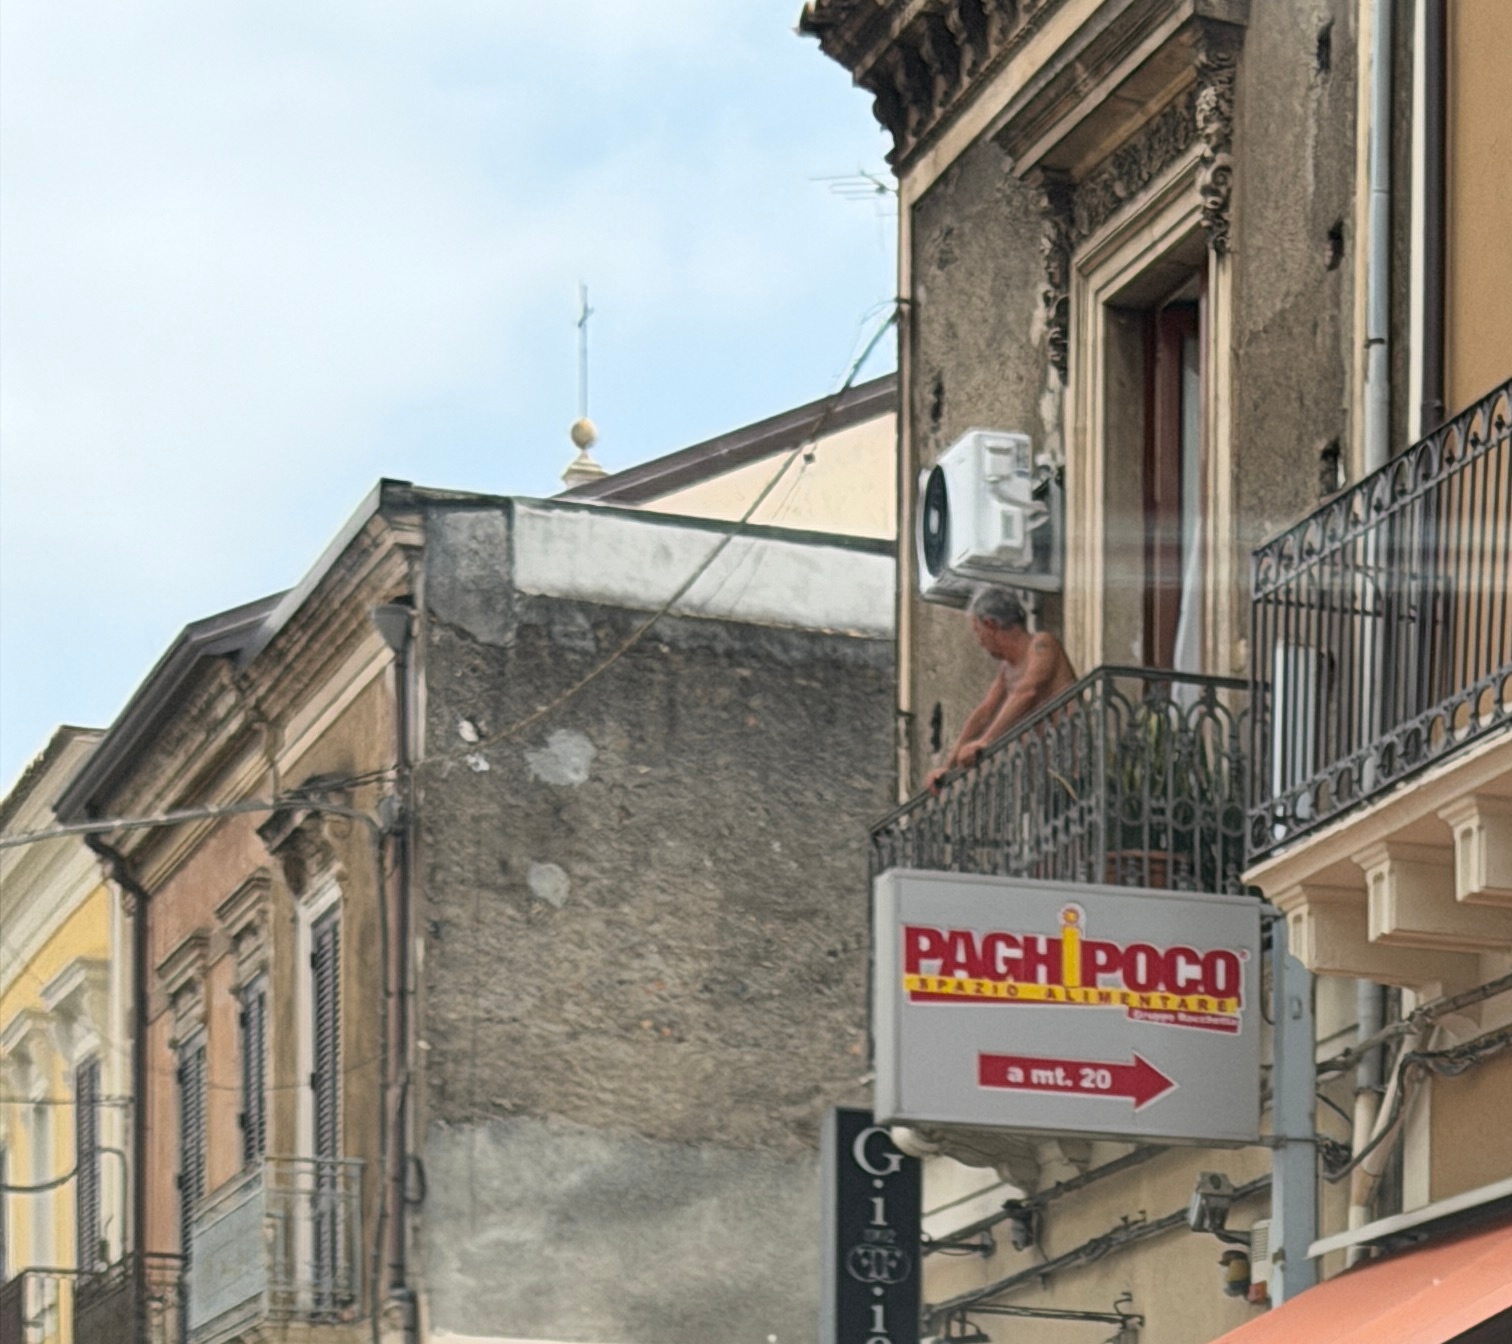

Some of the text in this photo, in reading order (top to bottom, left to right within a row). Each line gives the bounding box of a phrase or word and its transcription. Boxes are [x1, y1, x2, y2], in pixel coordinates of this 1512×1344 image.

[918, 977, 1229, 1013] SPAZIO ALIMENTARE
[1007, 1066, 1112, 1090] a mt. 20
